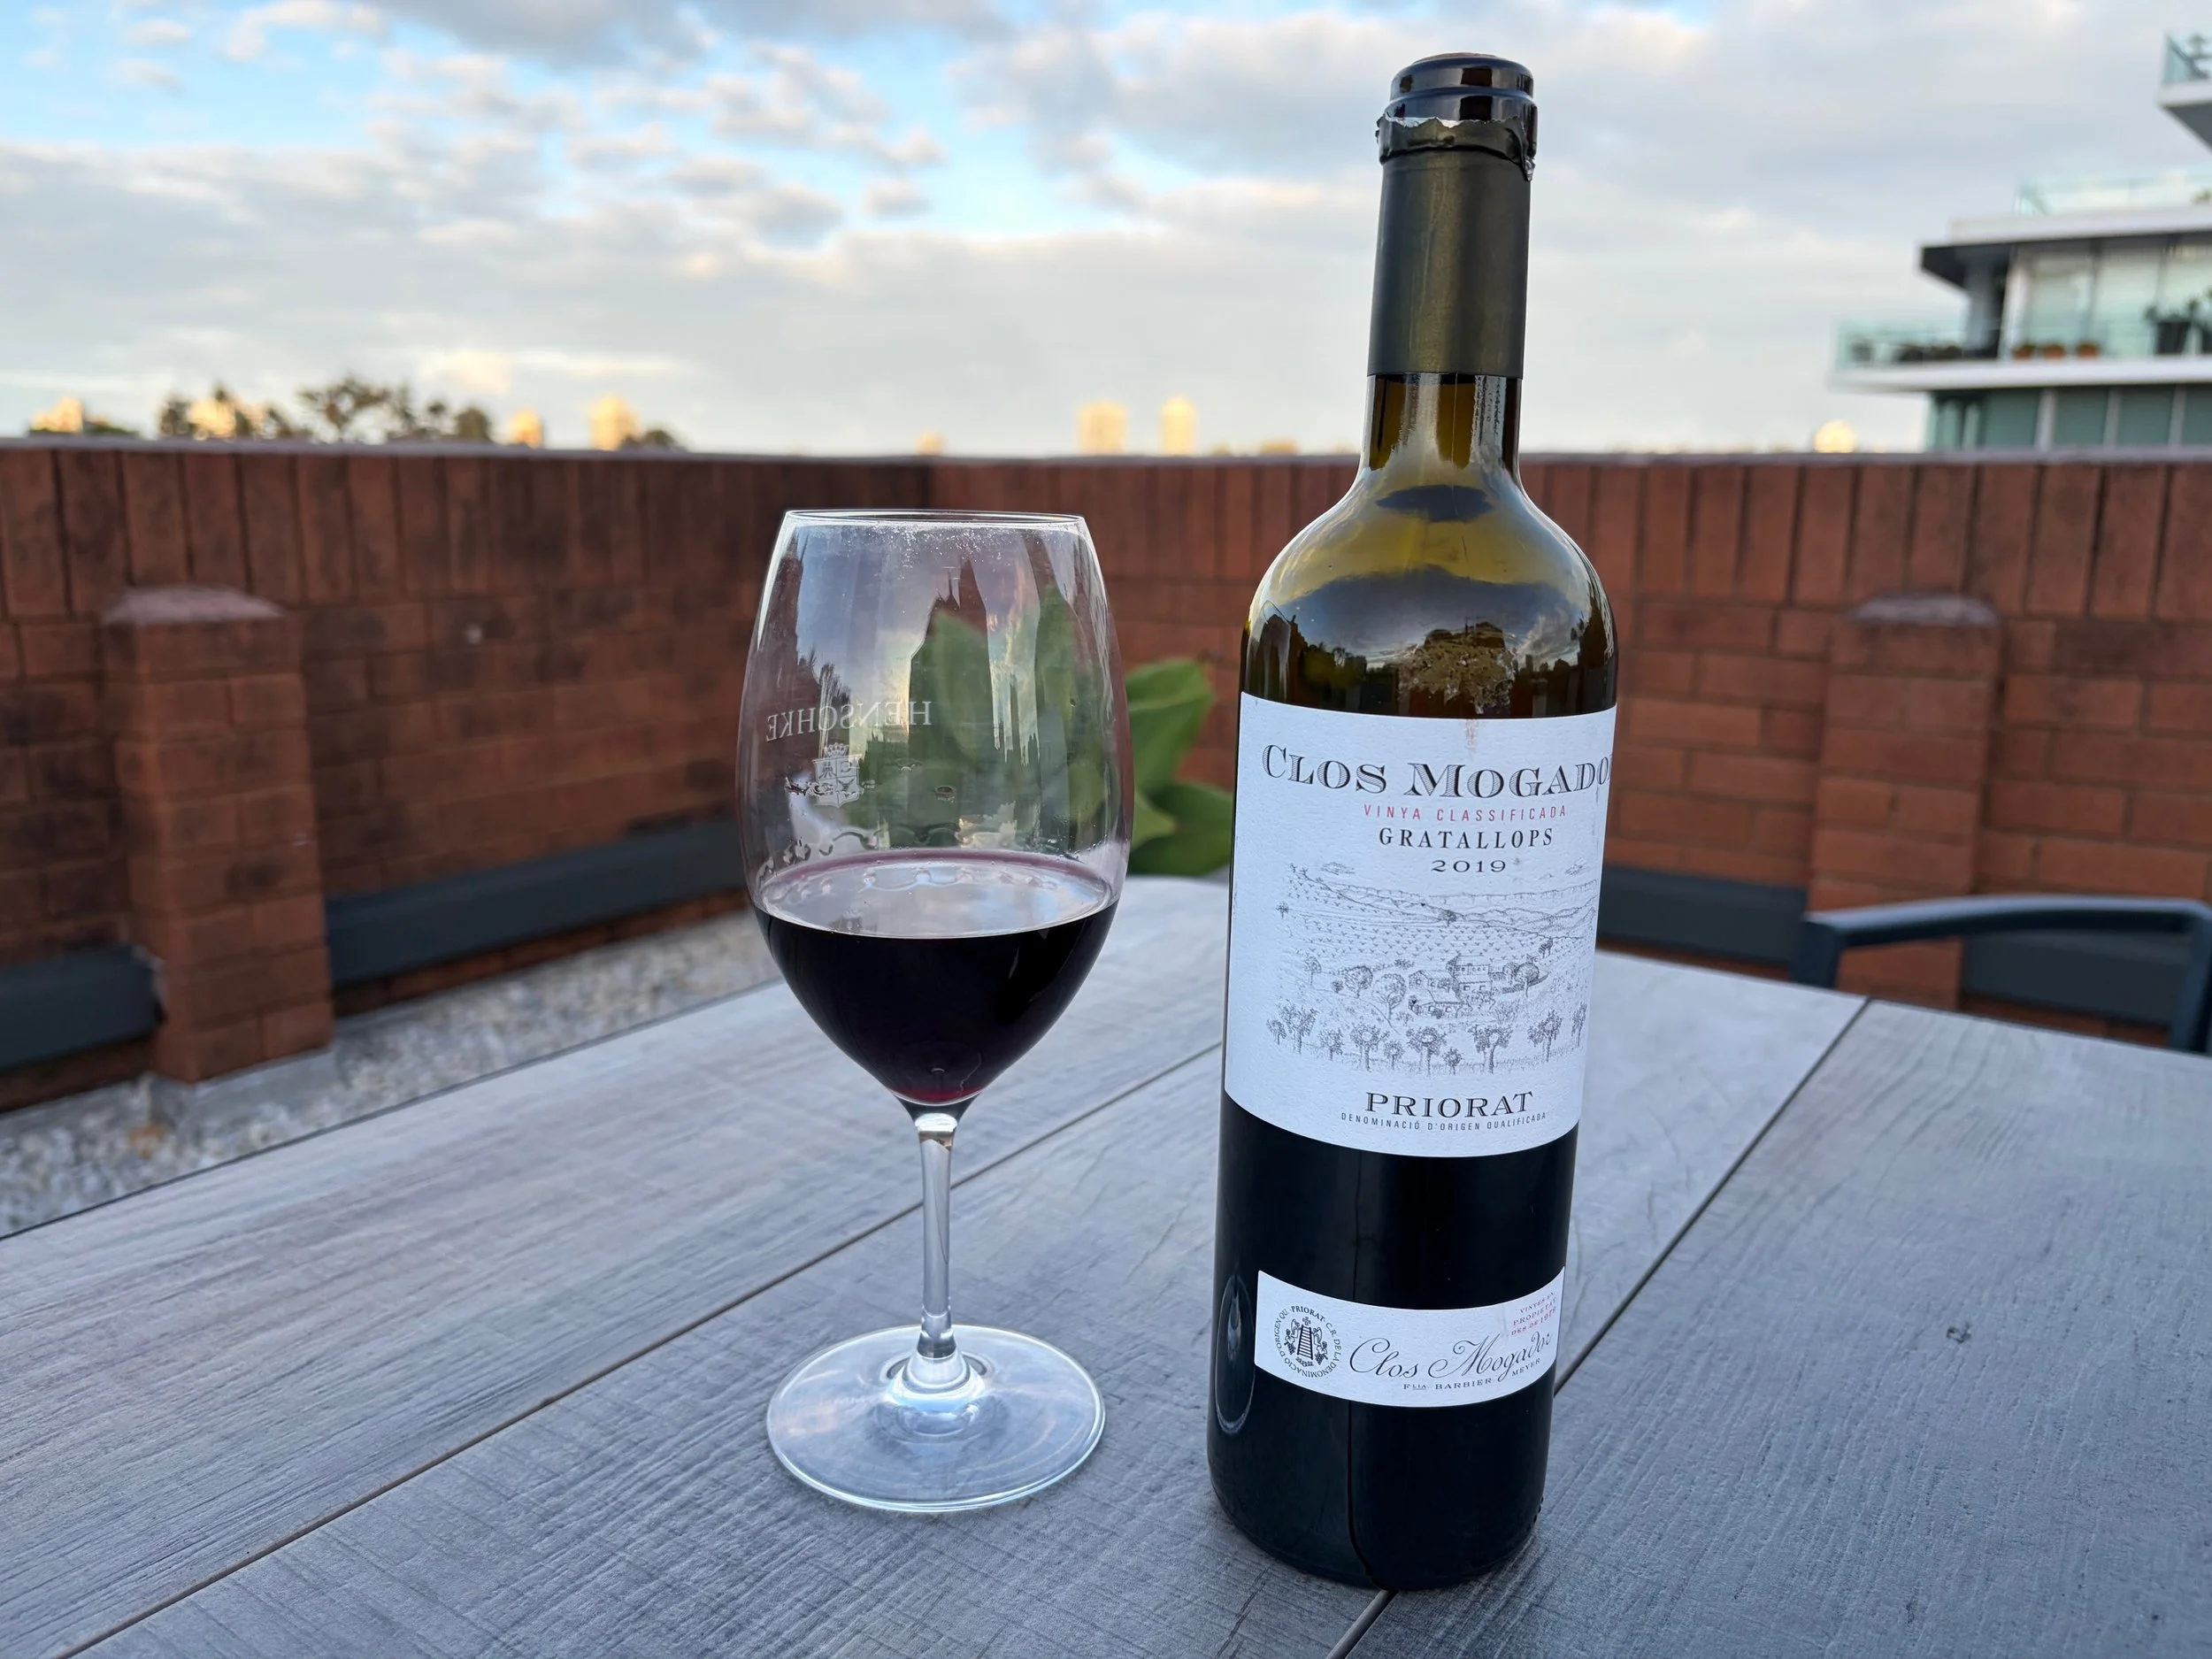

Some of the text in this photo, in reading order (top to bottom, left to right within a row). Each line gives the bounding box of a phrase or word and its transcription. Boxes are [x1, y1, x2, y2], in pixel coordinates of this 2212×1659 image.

[1262, 744, 1611, 798] CLOS MOGADO
[1363, 804, 1566, 822] VINYA CLASSIFICADA
[1379, 827, 1553, 849] GRATALLOPS
[1431, 859, 1506, 872] 2019
[1364, 1091, 1533, 1118] PRIORAT
[1427, 1122, 1480, 1131] D'ORIGEN
[1486, 1112, 1546, 1129] QUALIFICADA
[1349, 1337, 1418, 1378] Clos
[1435, 1378, 1492, 1390] BARBIER
